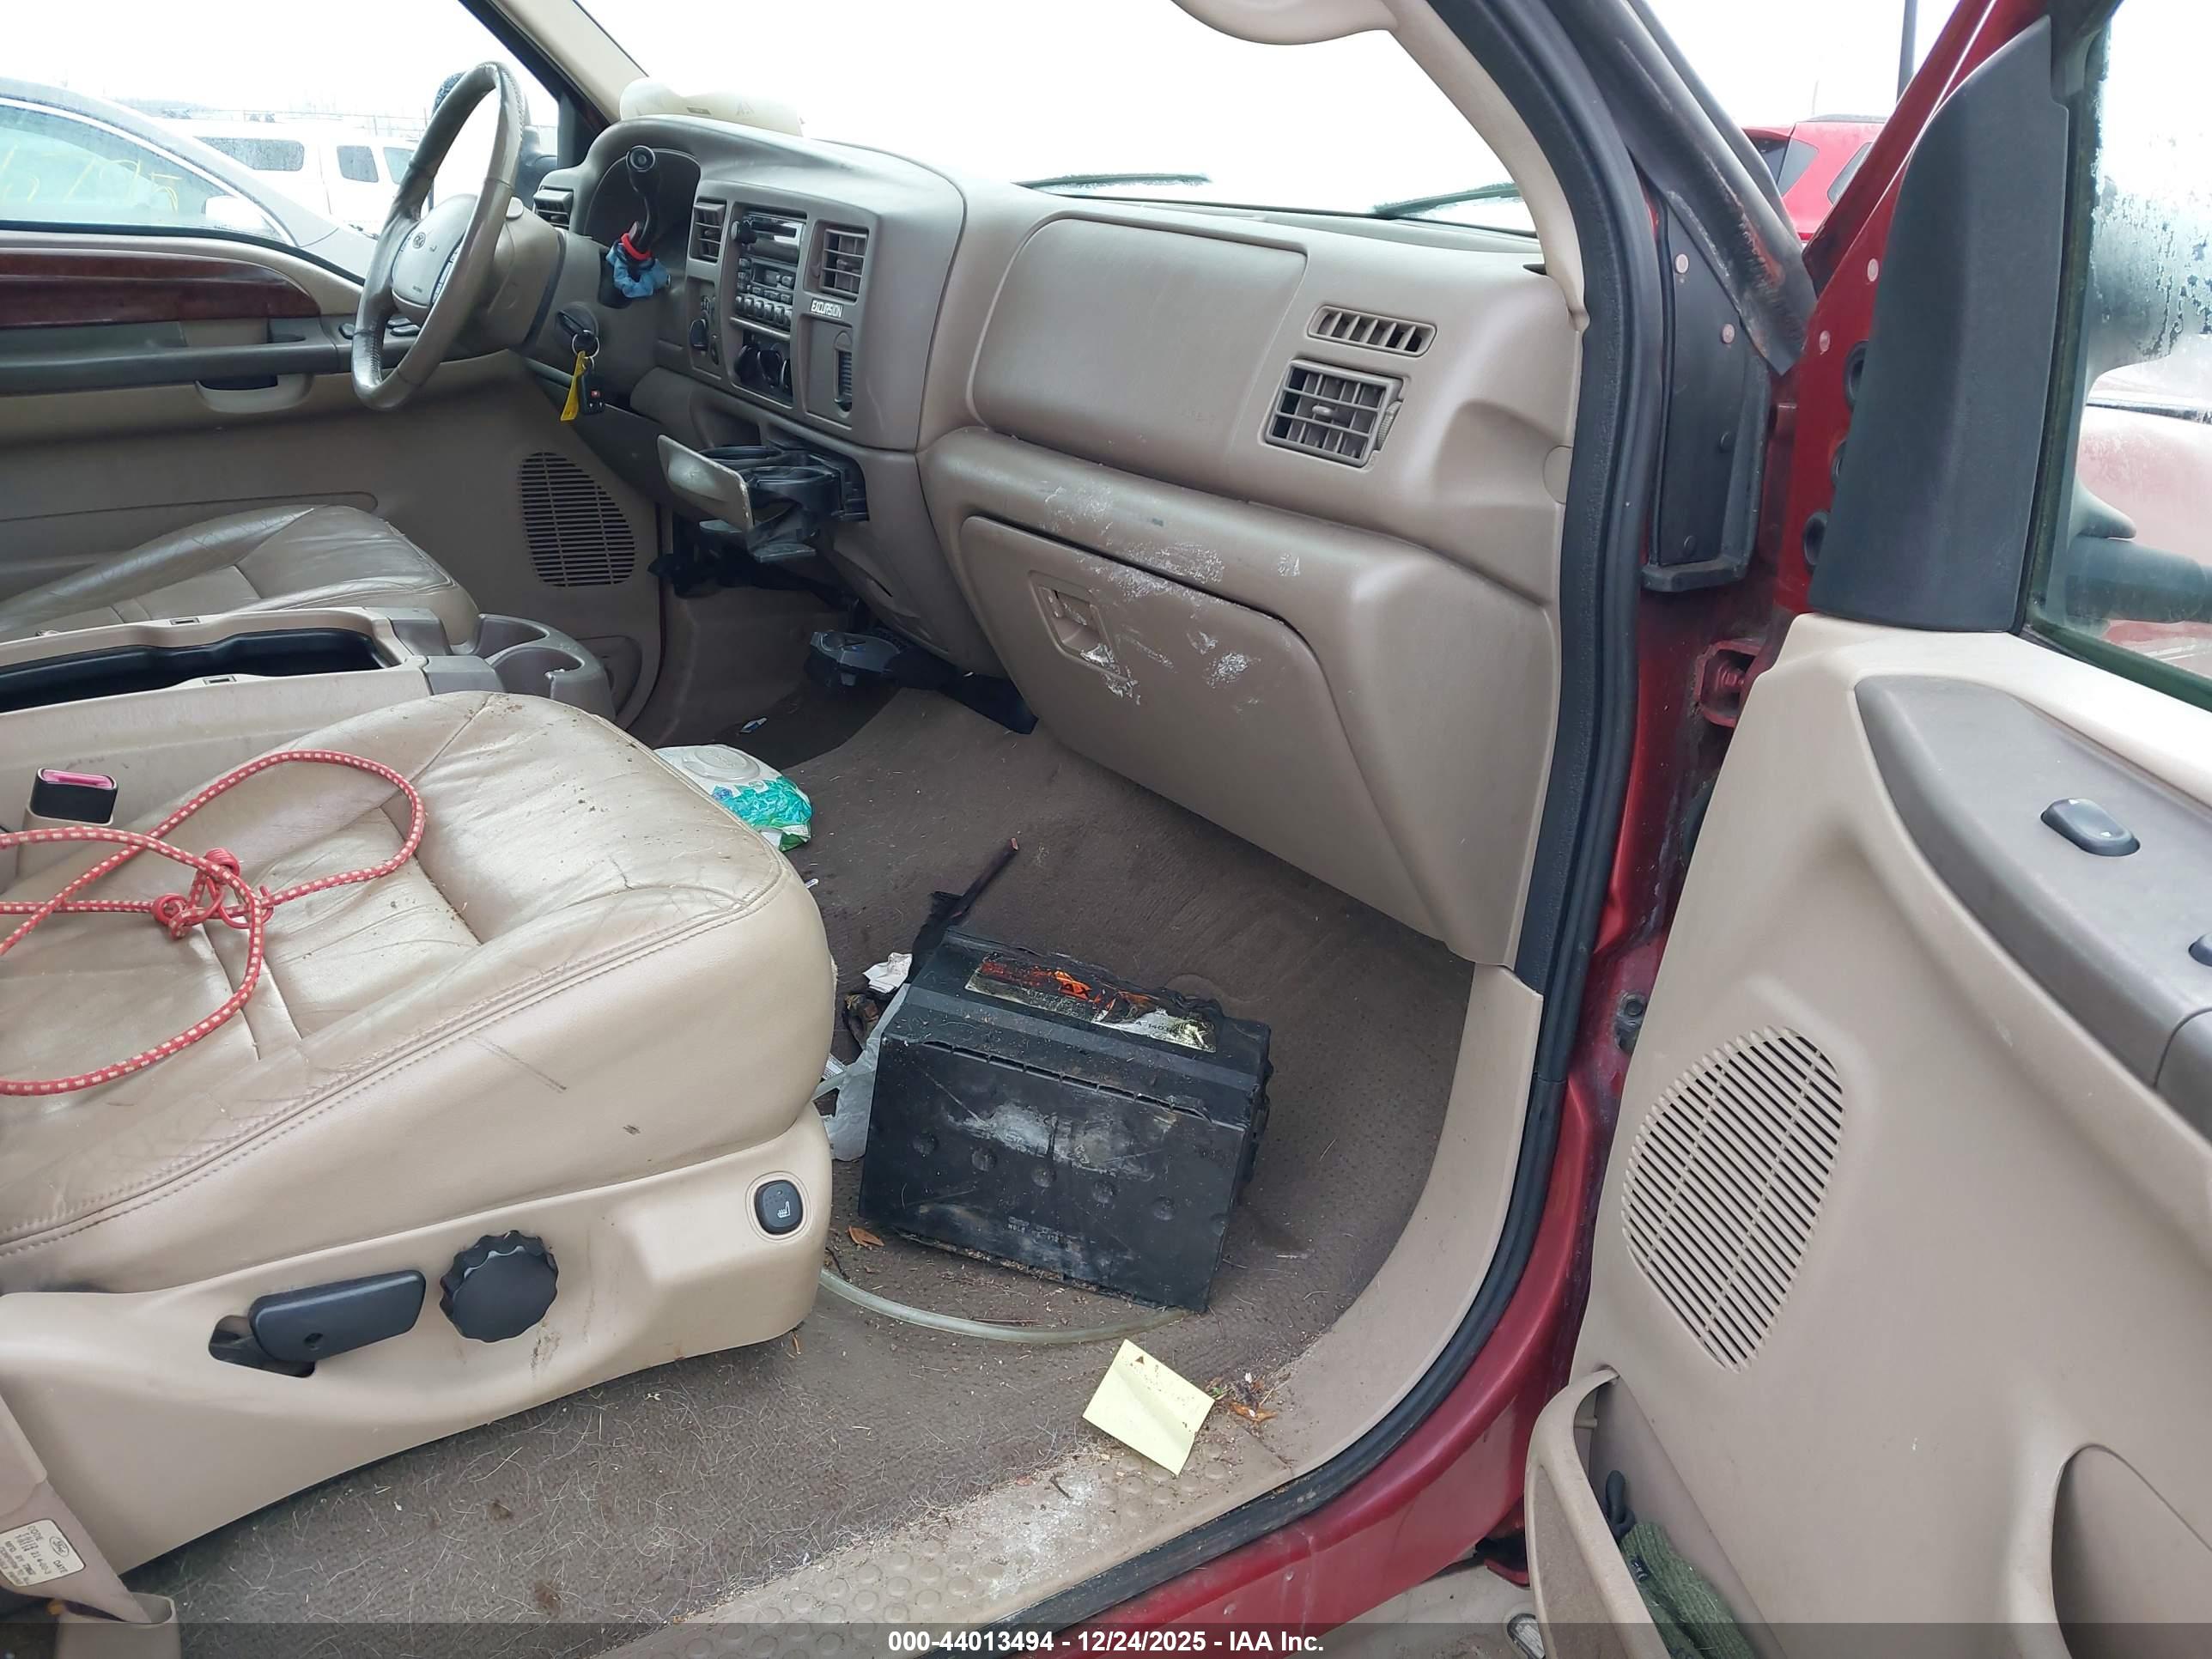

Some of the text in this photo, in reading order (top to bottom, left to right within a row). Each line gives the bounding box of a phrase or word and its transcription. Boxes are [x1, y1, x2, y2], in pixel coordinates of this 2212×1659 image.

[811, 300, 843, 319] EXCURSION
[27, 1525, 44, 1541] CODE
[53, 1559, 69, 1574] DATE
